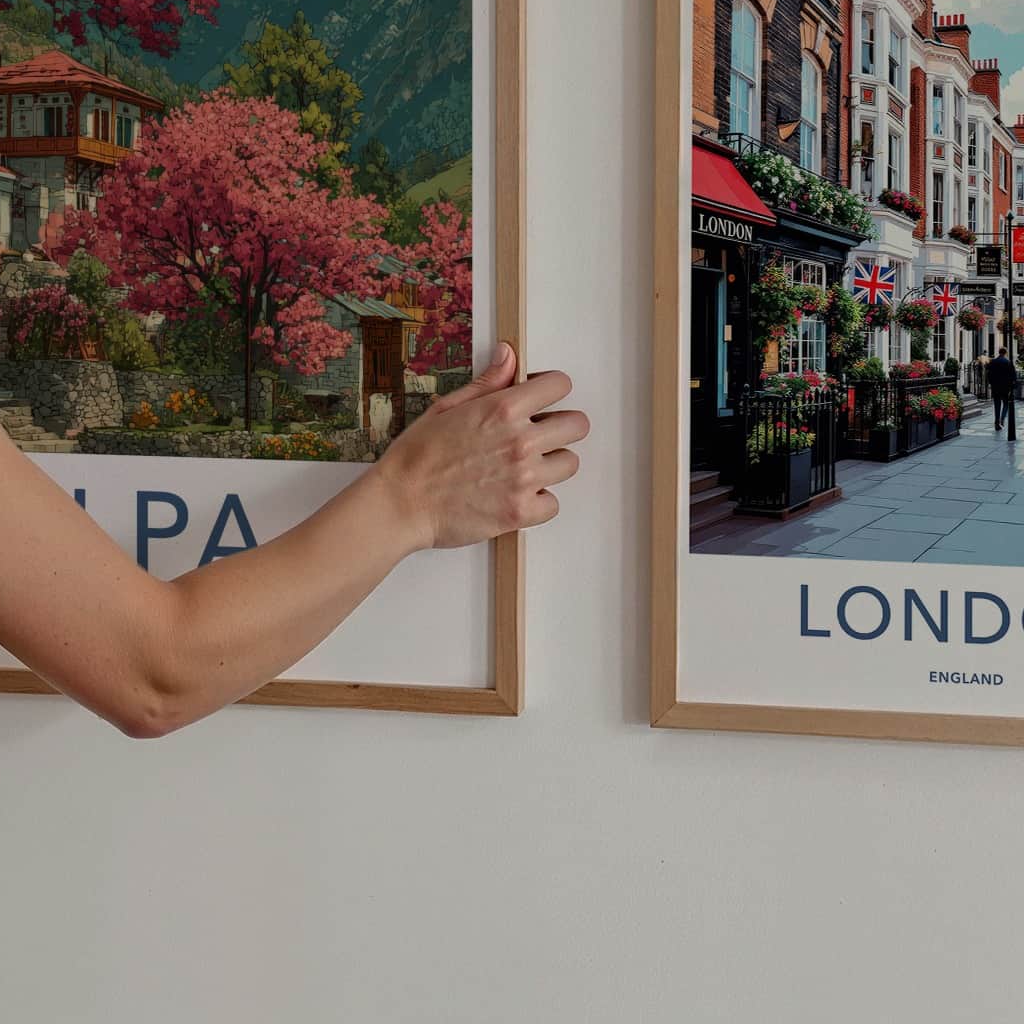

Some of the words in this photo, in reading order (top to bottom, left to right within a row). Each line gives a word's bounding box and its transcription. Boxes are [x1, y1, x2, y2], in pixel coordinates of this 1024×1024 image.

[699, 213, 753, 242] LONDON
[800, 584, 1024, 645] LOND
[929, 671, 1004, 686] ENGLAND
